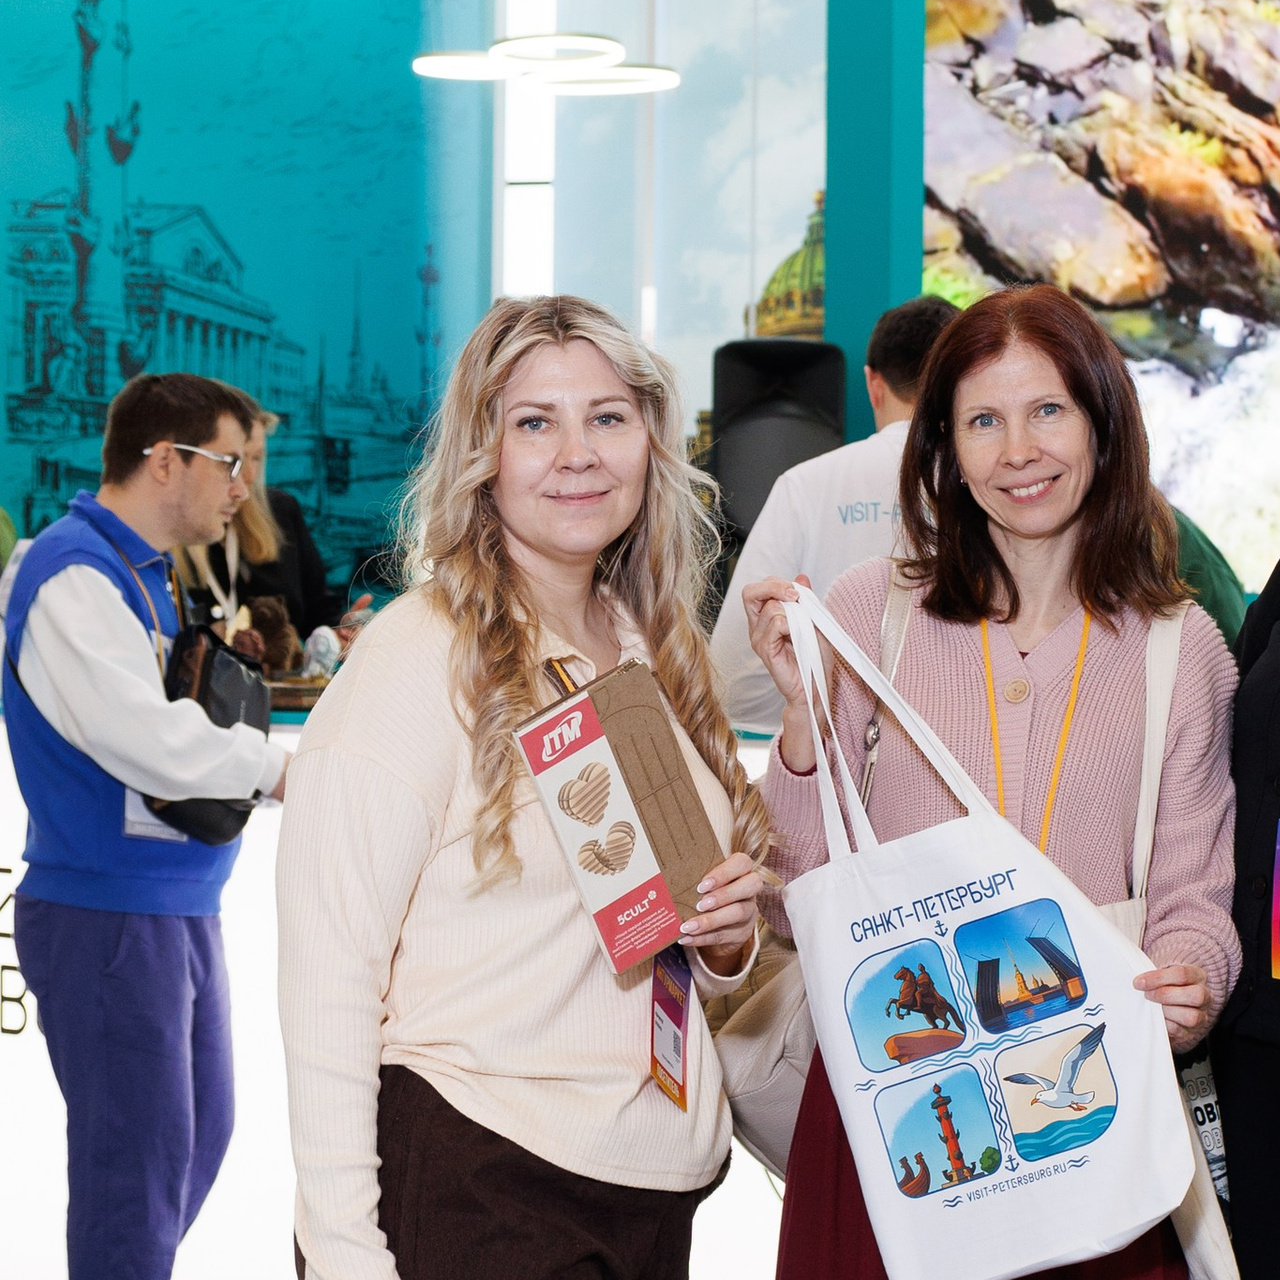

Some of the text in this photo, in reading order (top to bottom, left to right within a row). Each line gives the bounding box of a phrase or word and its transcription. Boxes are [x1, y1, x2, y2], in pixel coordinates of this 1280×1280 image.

[838, 501, 902, 525] VISIT-P
[542, 716, 582, 758] ITM
[617, 898, 650, 926] 5CULT
[850, 869, 1017, 943] САНКТ-ПЕТЕРБУРГ
[966, 1162, 1067, 1202] VISIT-PETERSBURG.RU
